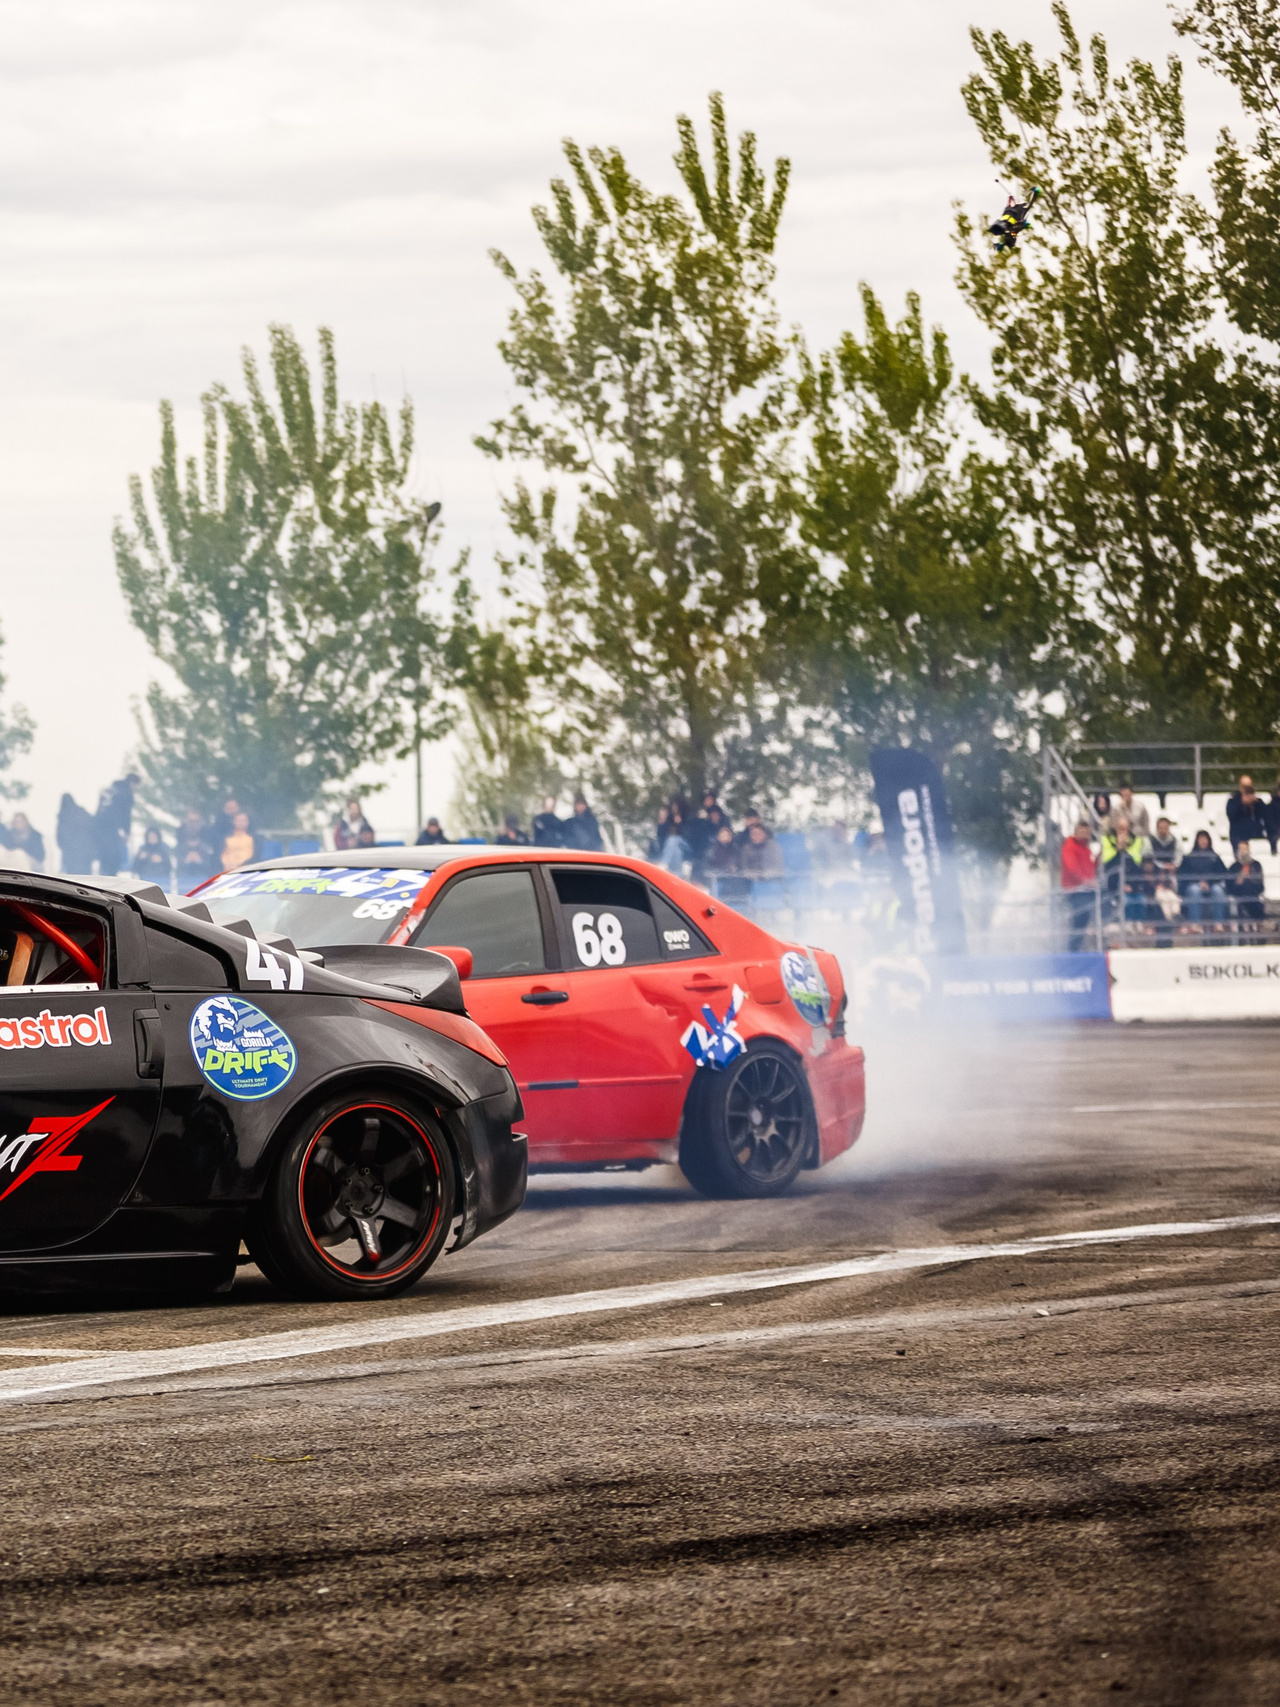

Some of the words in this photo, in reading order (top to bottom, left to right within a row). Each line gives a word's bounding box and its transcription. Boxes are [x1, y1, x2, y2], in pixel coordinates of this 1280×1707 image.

[352, 898, 400, 920] 68
[572, 912, 626, 967] 68
[244, 937, 304, 990] 47
[240, 1037, 273, 1048] GORILLA
